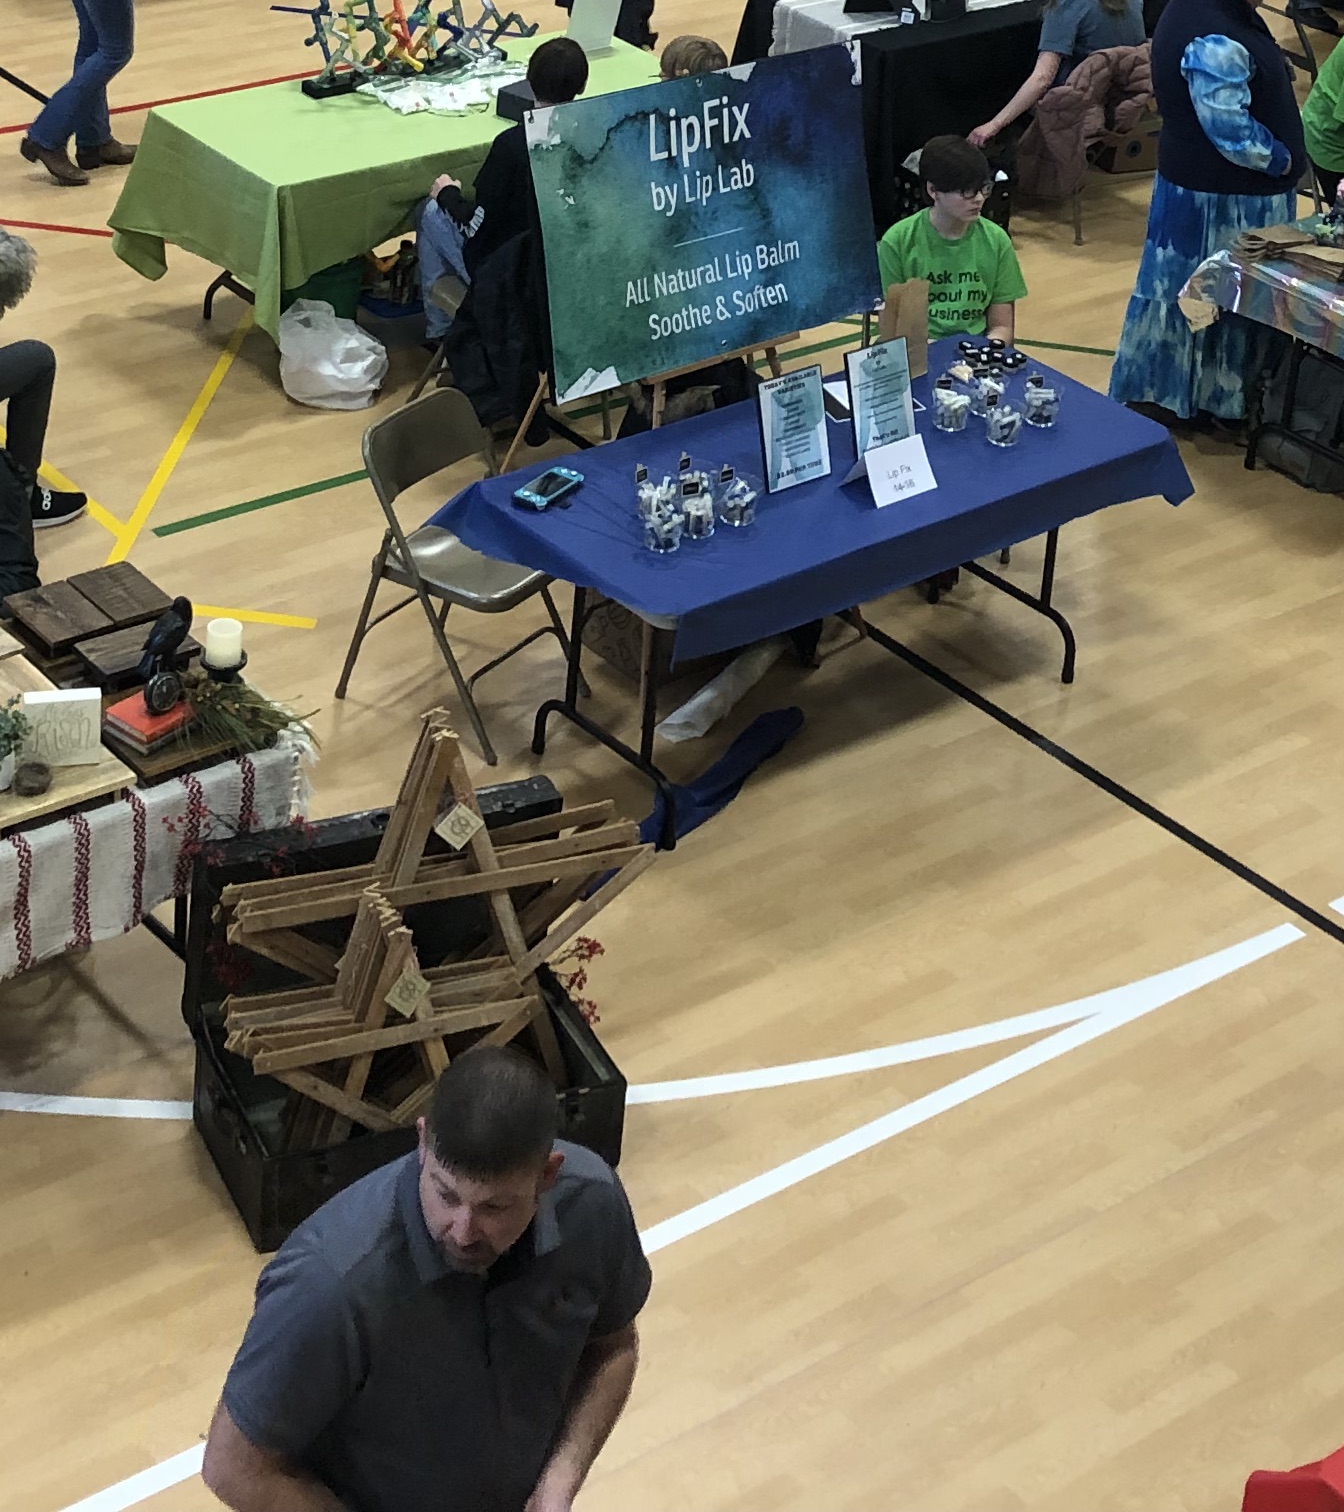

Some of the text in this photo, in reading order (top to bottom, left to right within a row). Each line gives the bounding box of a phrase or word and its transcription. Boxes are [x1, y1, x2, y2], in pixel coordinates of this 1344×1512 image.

[649, 96, 752, 168] LipFix
[651, 158, 755, 217] by Lip Lab
[625, 240, 800, 308] All Natural Lip Balm
[927, 270, 953, 285] Ask
[967, 289, 988, 303] my
[648, 282, 789, 341] Soothe & Soften
[928, 308, 985, 322] usiness
